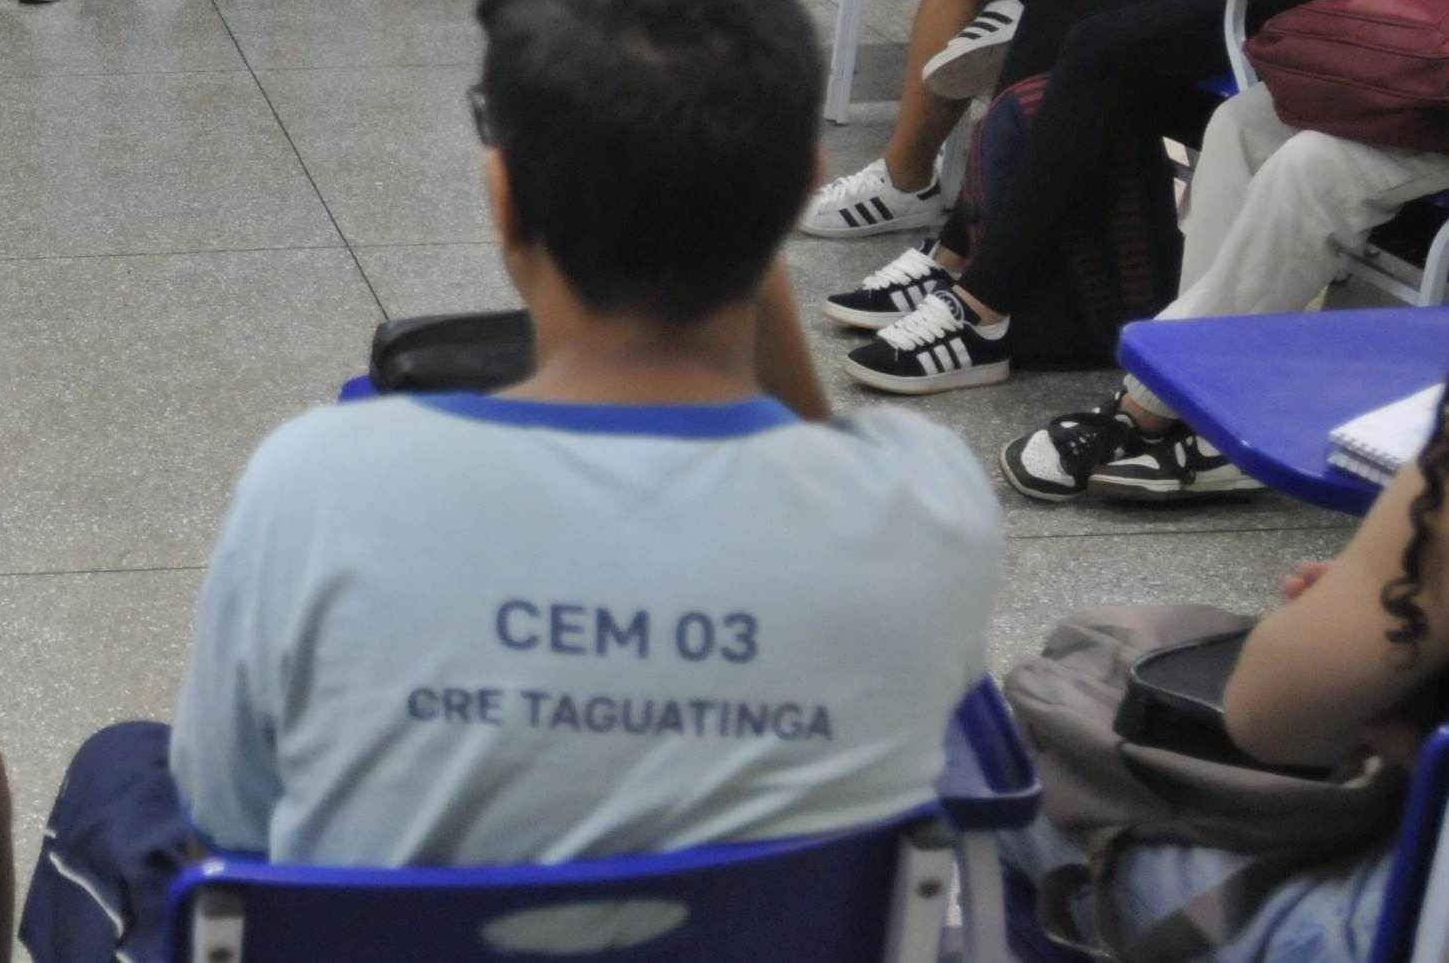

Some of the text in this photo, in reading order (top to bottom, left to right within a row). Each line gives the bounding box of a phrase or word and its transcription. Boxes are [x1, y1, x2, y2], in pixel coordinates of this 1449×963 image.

[495, 599, 759, 663] CEM 03
[407, 687, 834, 741] CRE TAGUATINGA
